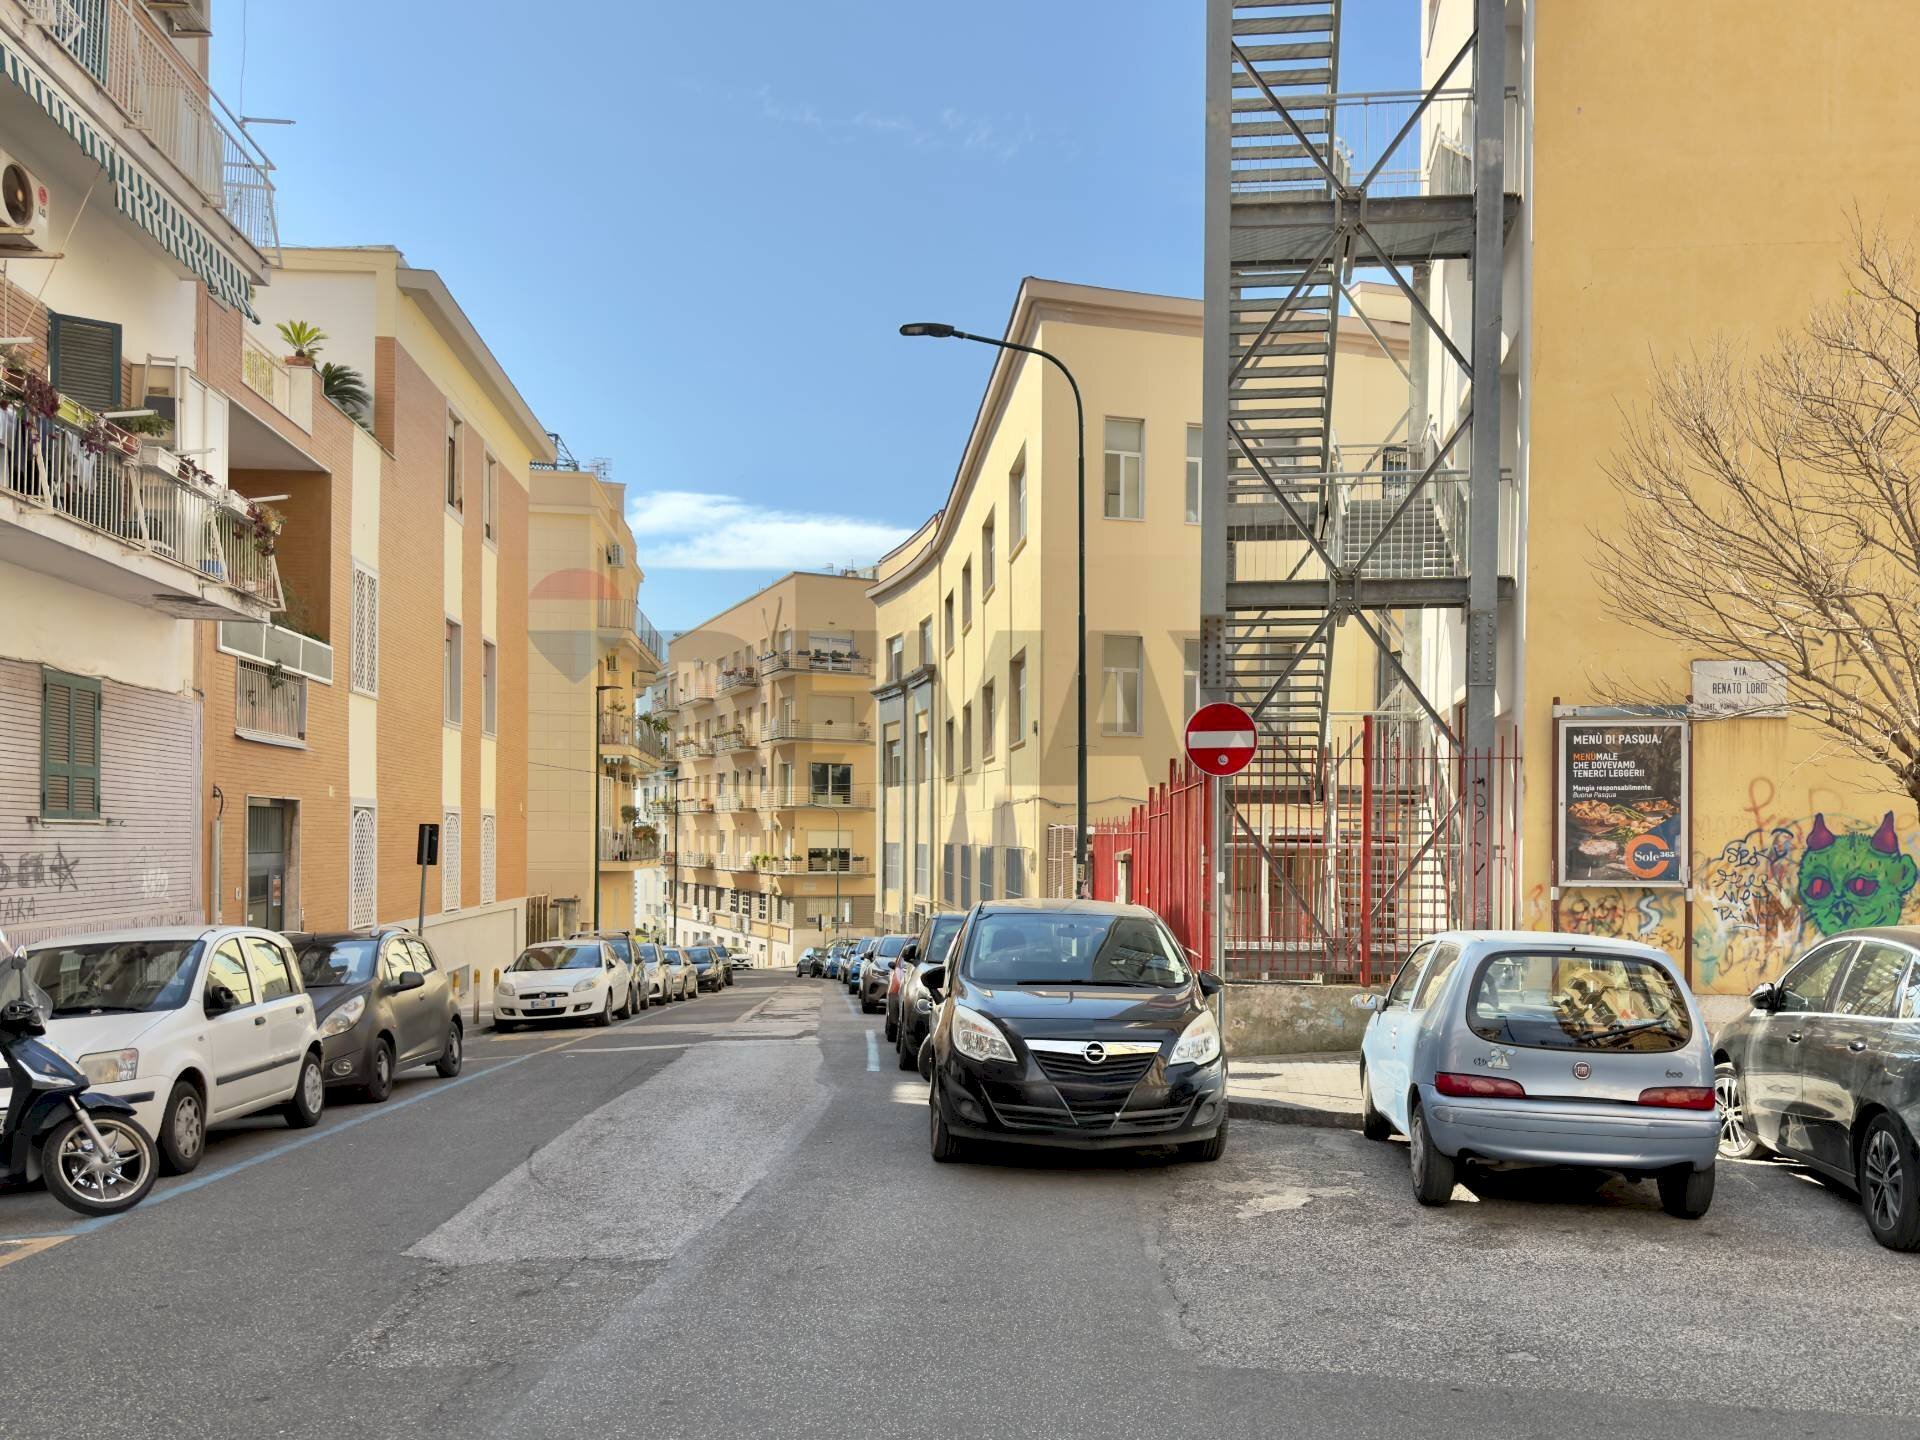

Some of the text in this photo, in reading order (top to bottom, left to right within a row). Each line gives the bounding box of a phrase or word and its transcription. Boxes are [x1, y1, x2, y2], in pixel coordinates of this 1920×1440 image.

[1733, 666, 1747, 676] VIA
[1712, 682, 1742, 694] RENATO
[1573, 732, 1602, 745] MENÙ
[1605, 734, 1616, 745] DI
[1573, 761, 1636, 770] CHE DOVEVAMO
[1573, 769, 1645, 778] TENERCI LEGGERI!
[1572, 785, 1595, 793] Mangia
